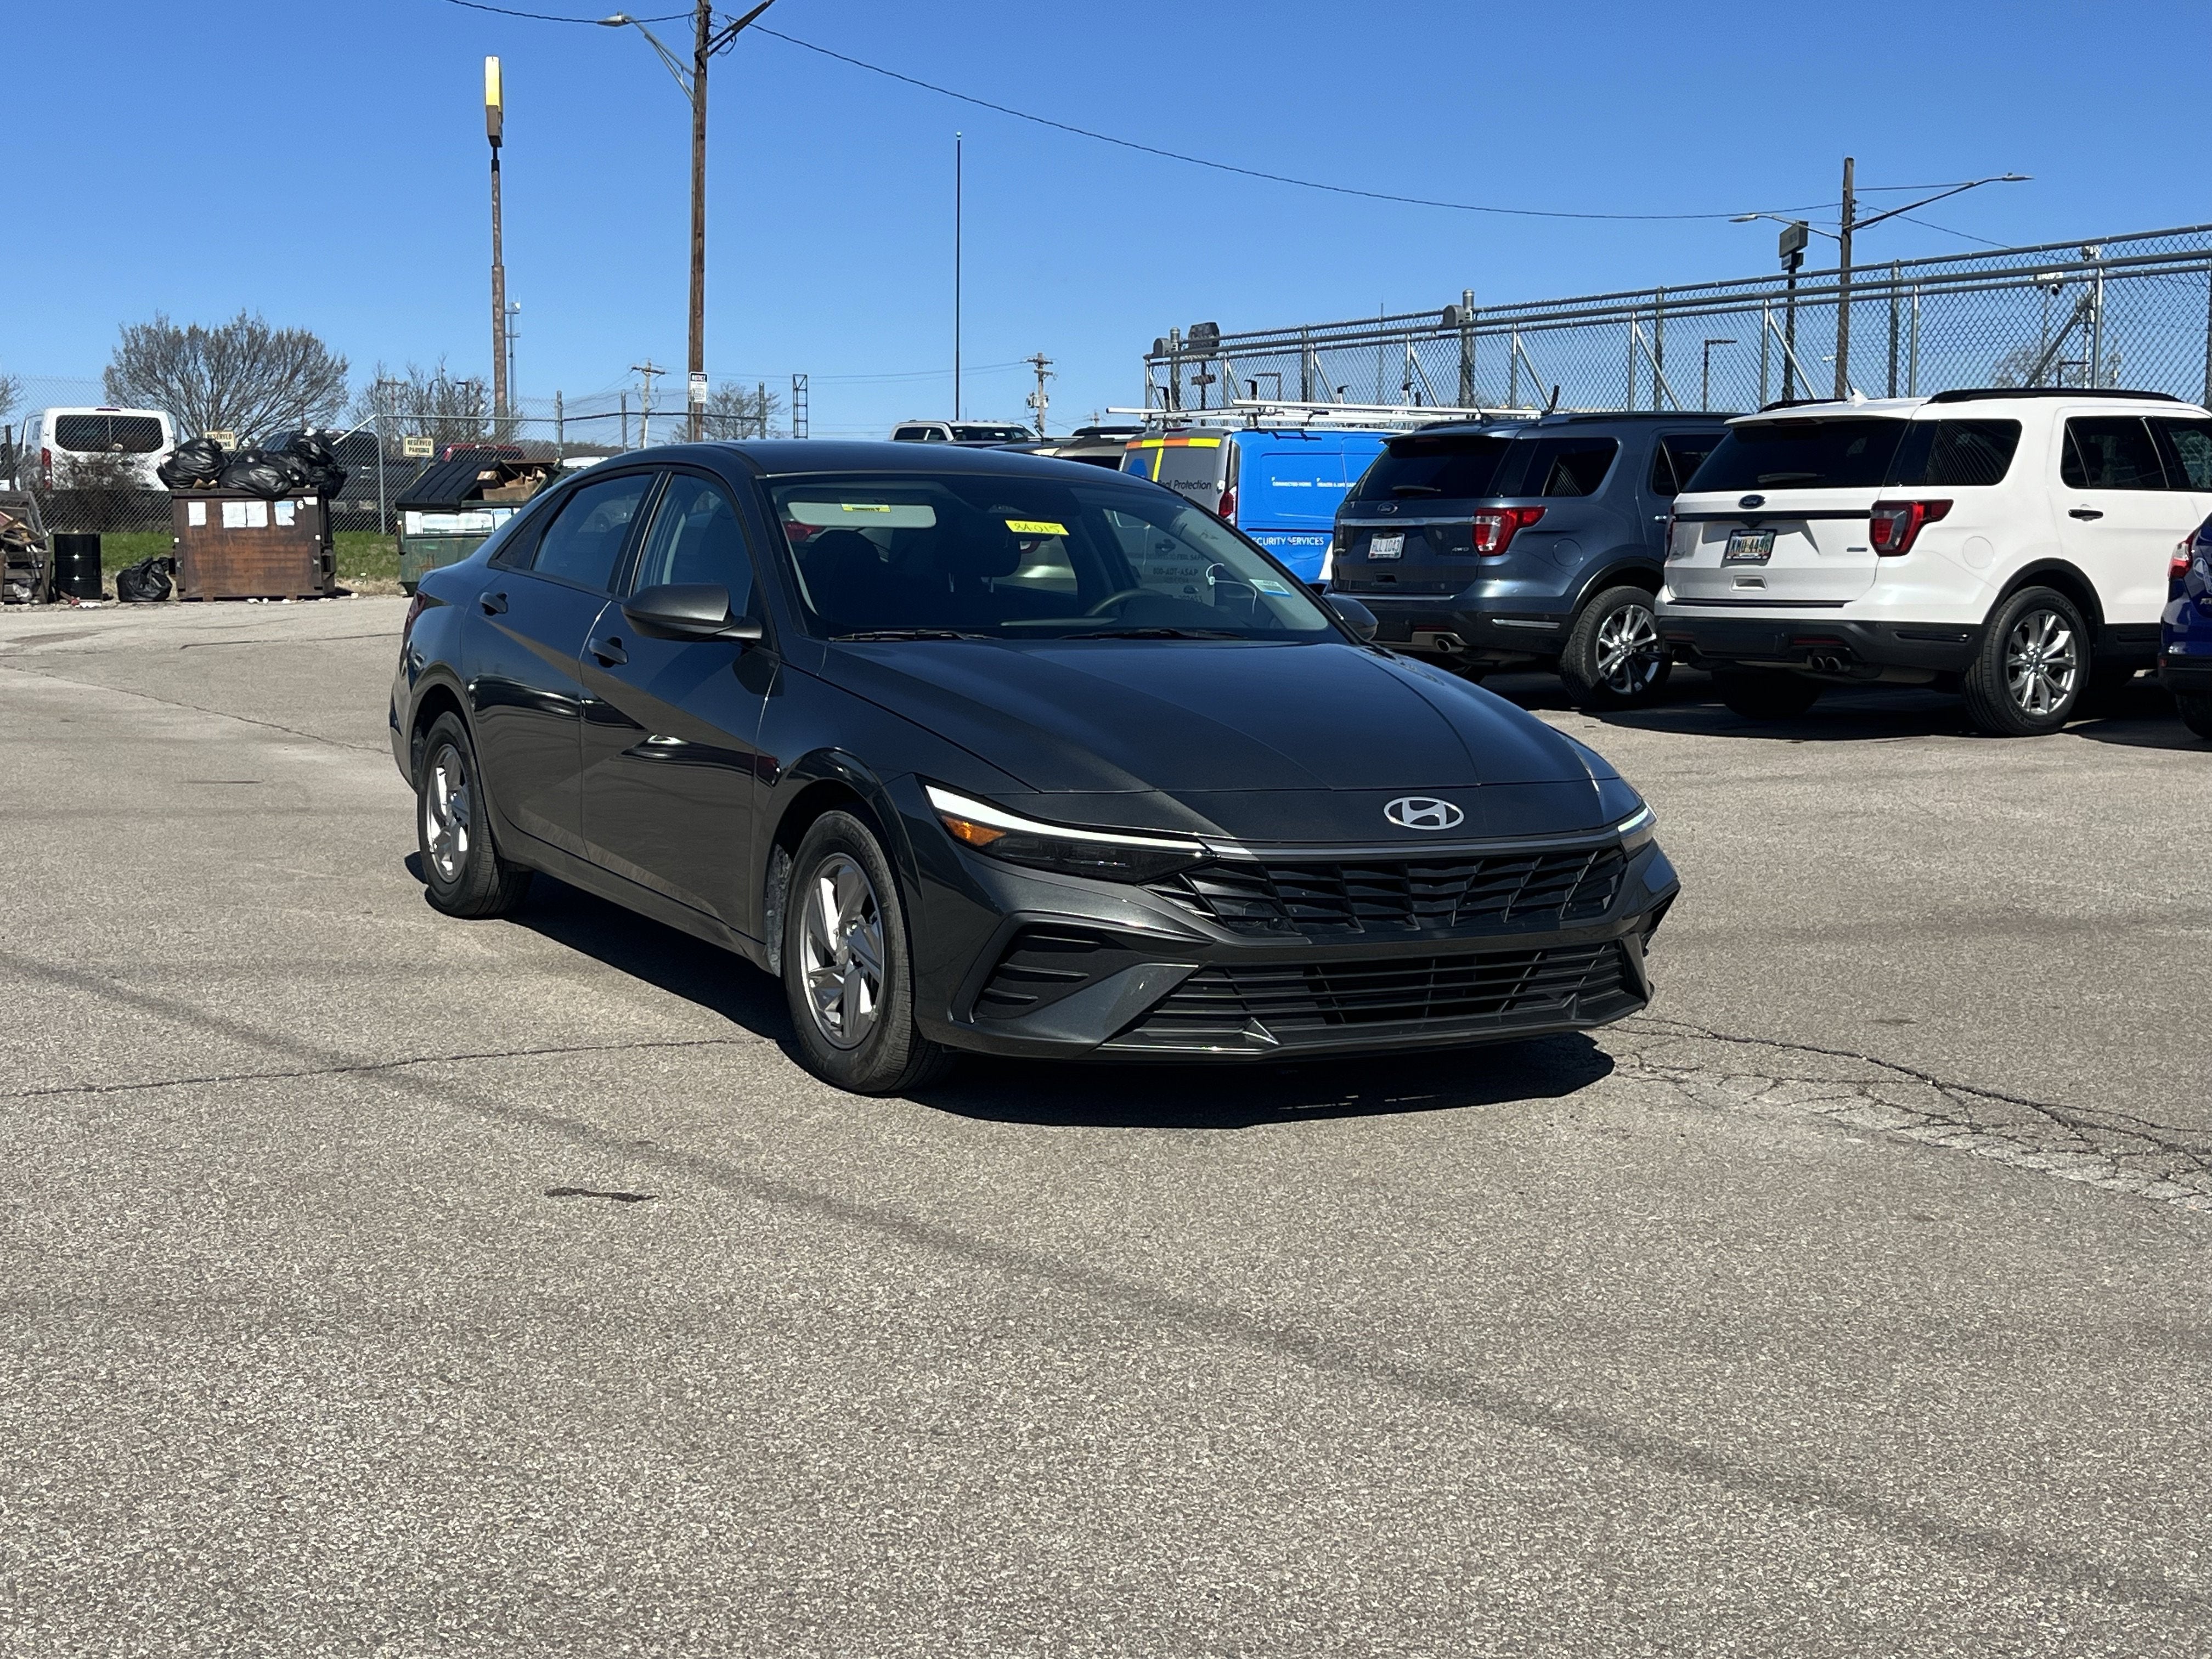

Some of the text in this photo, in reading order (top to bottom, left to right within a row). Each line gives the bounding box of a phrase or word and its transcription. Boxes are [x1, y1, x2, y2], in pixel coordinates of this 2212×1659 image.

[1174, 479, 1212, 490] Protection
[297, 500, 304, 510] 6
[1251, 537, 1324, 546] ECURITY SERVICES
